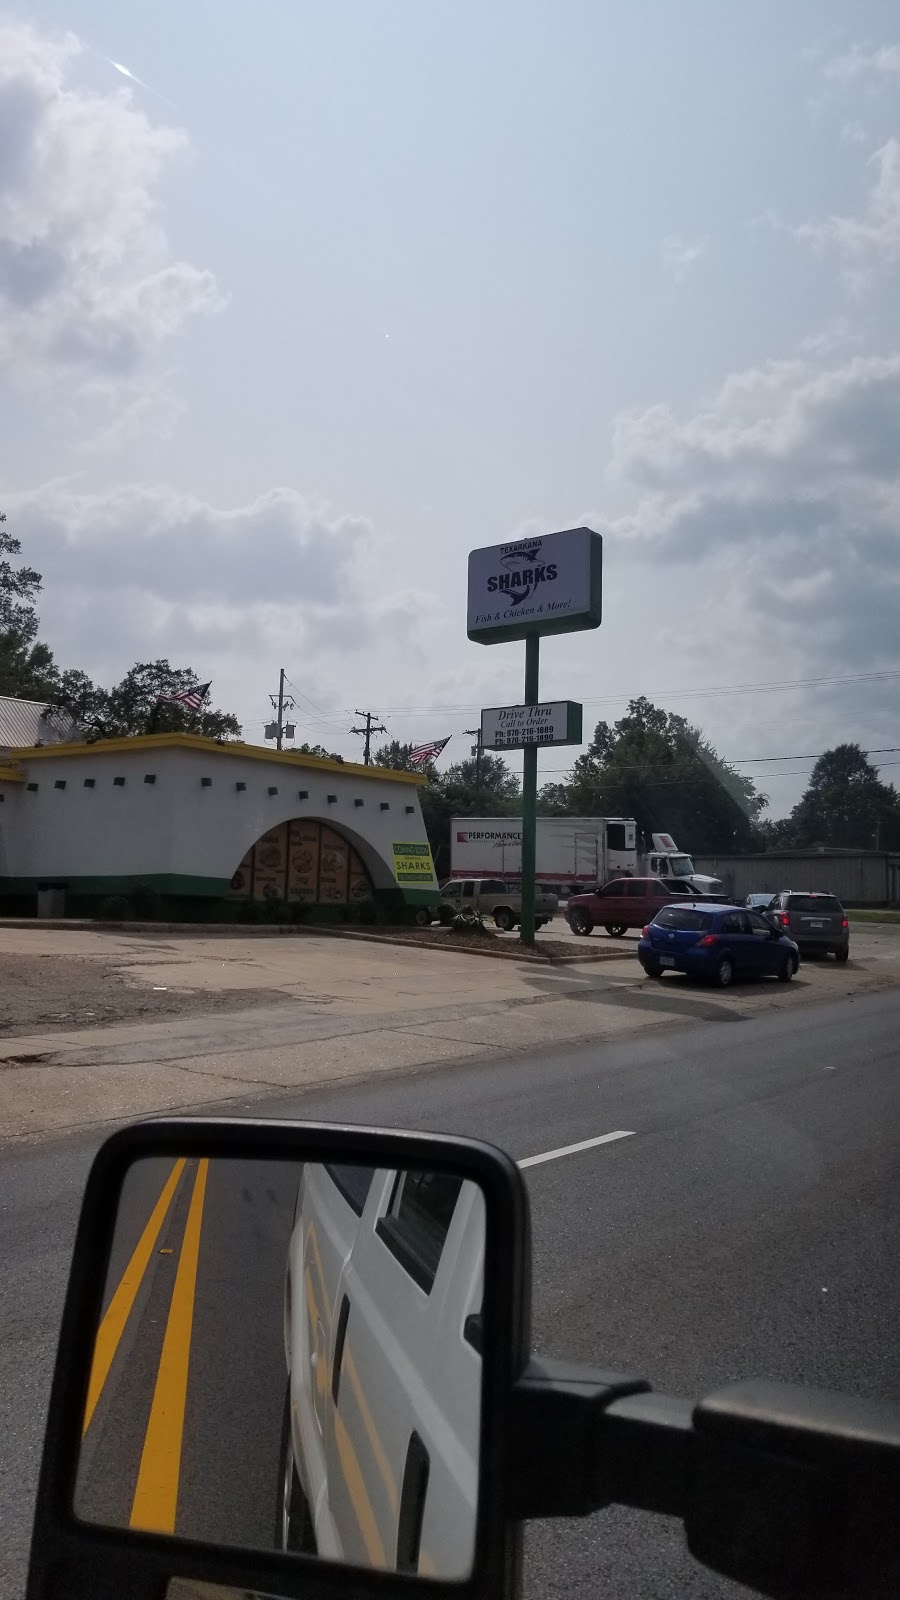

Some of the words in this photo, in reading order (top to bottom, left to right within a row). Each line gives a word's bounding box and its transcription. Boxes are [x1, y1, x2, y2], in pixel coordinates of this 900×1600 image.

[500, 539, 542, 554] TEXARKANA
[487, 564, 558, 592] SHARKS
[475, 615, 492, 623] Fish
[494, 612, 501, 620] &
[503, 607, 535, 618] Chicken
[537, 605, 543, 613] &
[546, 598, 572, 611] More!
[498, 709, 525, 720] Drive
[528, 707, 552, 717] Thru
[500, 719, 516, 728] Call
[517, 719, 524, 727] to
[526, 717, 548, 726] Order
[495, 730, 506, 738] Ph:
[507, 725, 554, 737] 870-216-1889
[468, 832, 522, 840] PERFORMANCE
[396, 861, 431, 871] SHARKS
